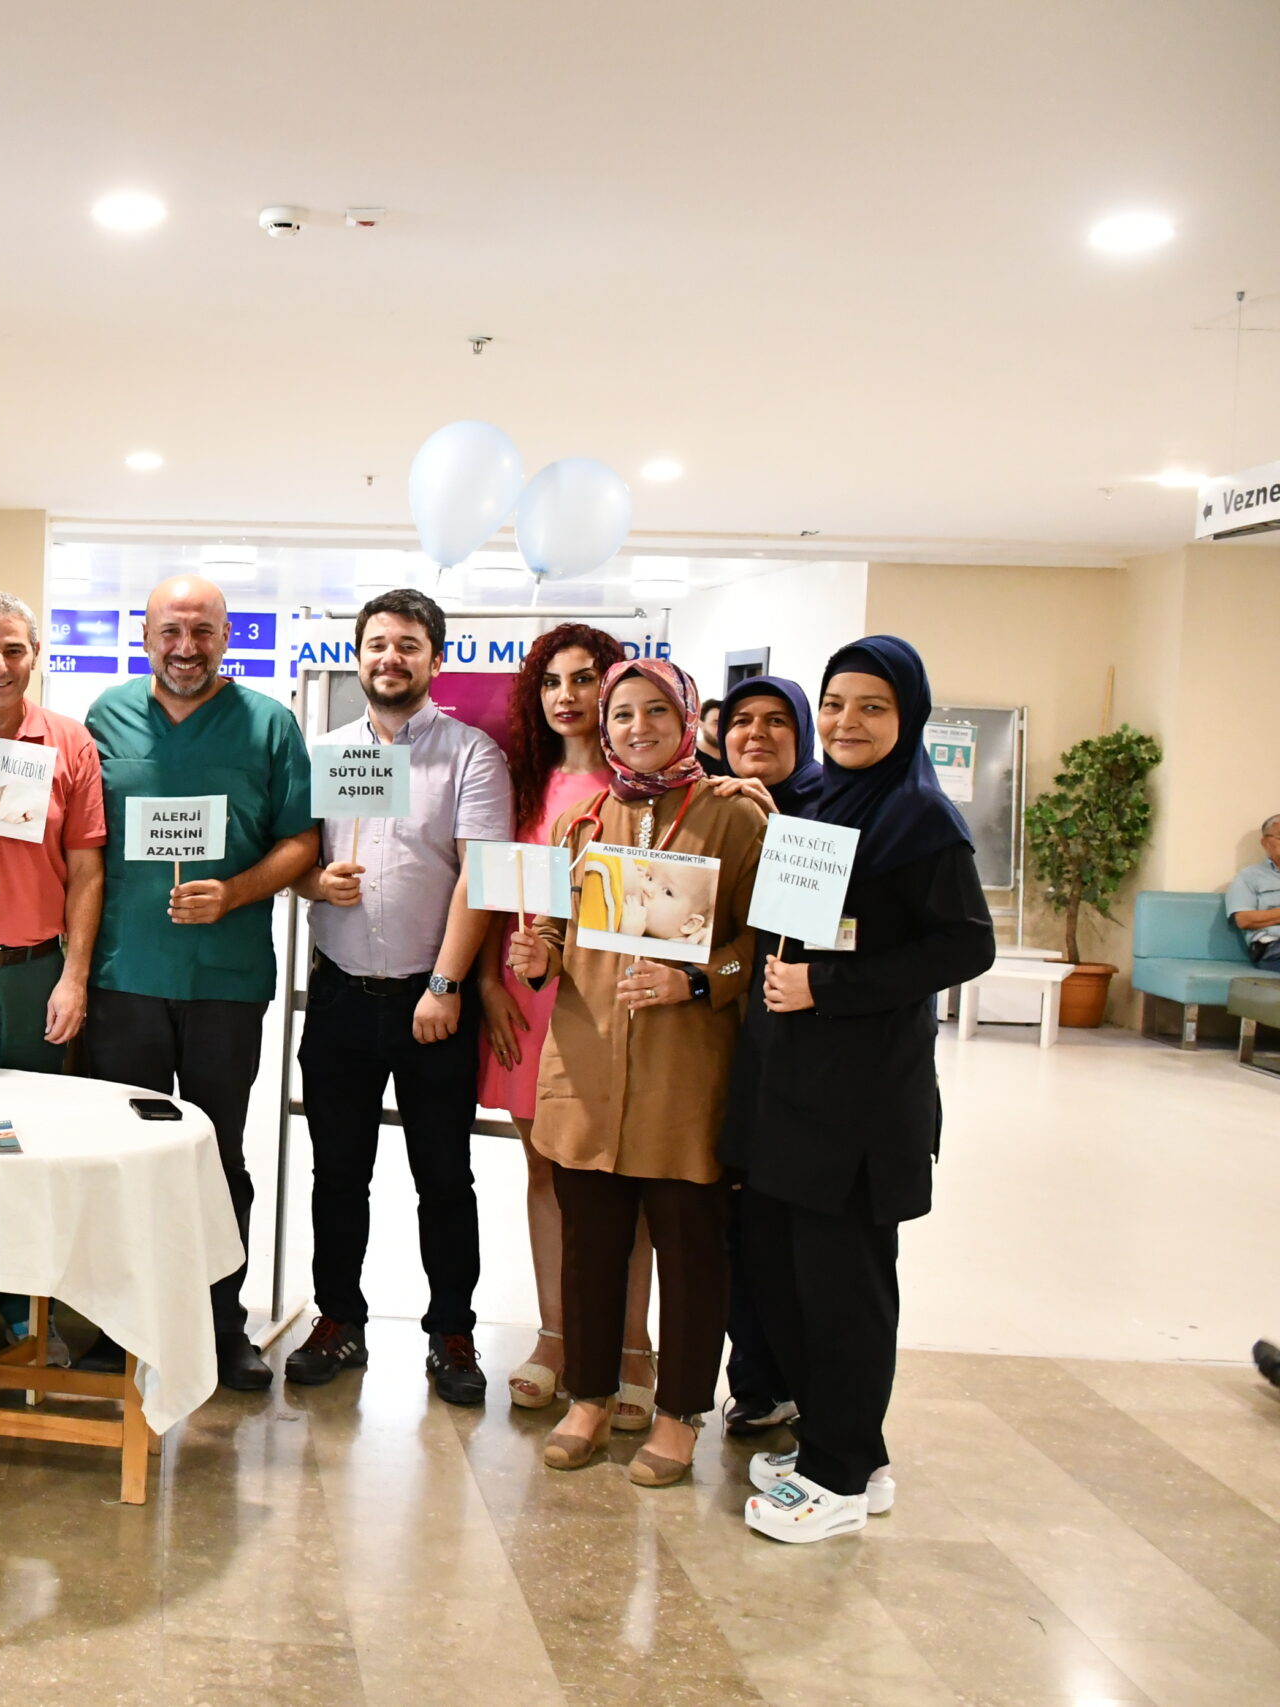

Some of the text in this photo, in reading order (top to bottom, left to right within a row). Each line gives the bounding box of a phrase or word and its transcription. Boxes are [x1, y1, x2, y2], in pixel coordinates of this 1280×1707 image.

[1223, 484, 1280, 515] Vezne
[248, 623, 260, 640] 3
[298, 641, 359, 663] ANN
[443, 634, 476, 663] TÜ
[49, 656, 77, 672] akit
[218, 661, 245, 676] artı
[342, 749, 381, 760] ANNE
[329, 765, 394, 778] SÜTÜ İLK
[337, 785, 385, 798] AŞIDIR
[151, 809, 202, 822] ALERJİ
[149, 826, 203, 839] RİSKİNİ
[780, 833, 806, 848] ANNE
[146, 846, 206, 857] AZALTIR
[603, 845, 707, 865] ANNE SÜTÜ EKONOMİKTİR
[763, 848, 849, 878] ZEKA GELİŞİMİNİ
[777, 871, 821, 892] ARTIRIR.
